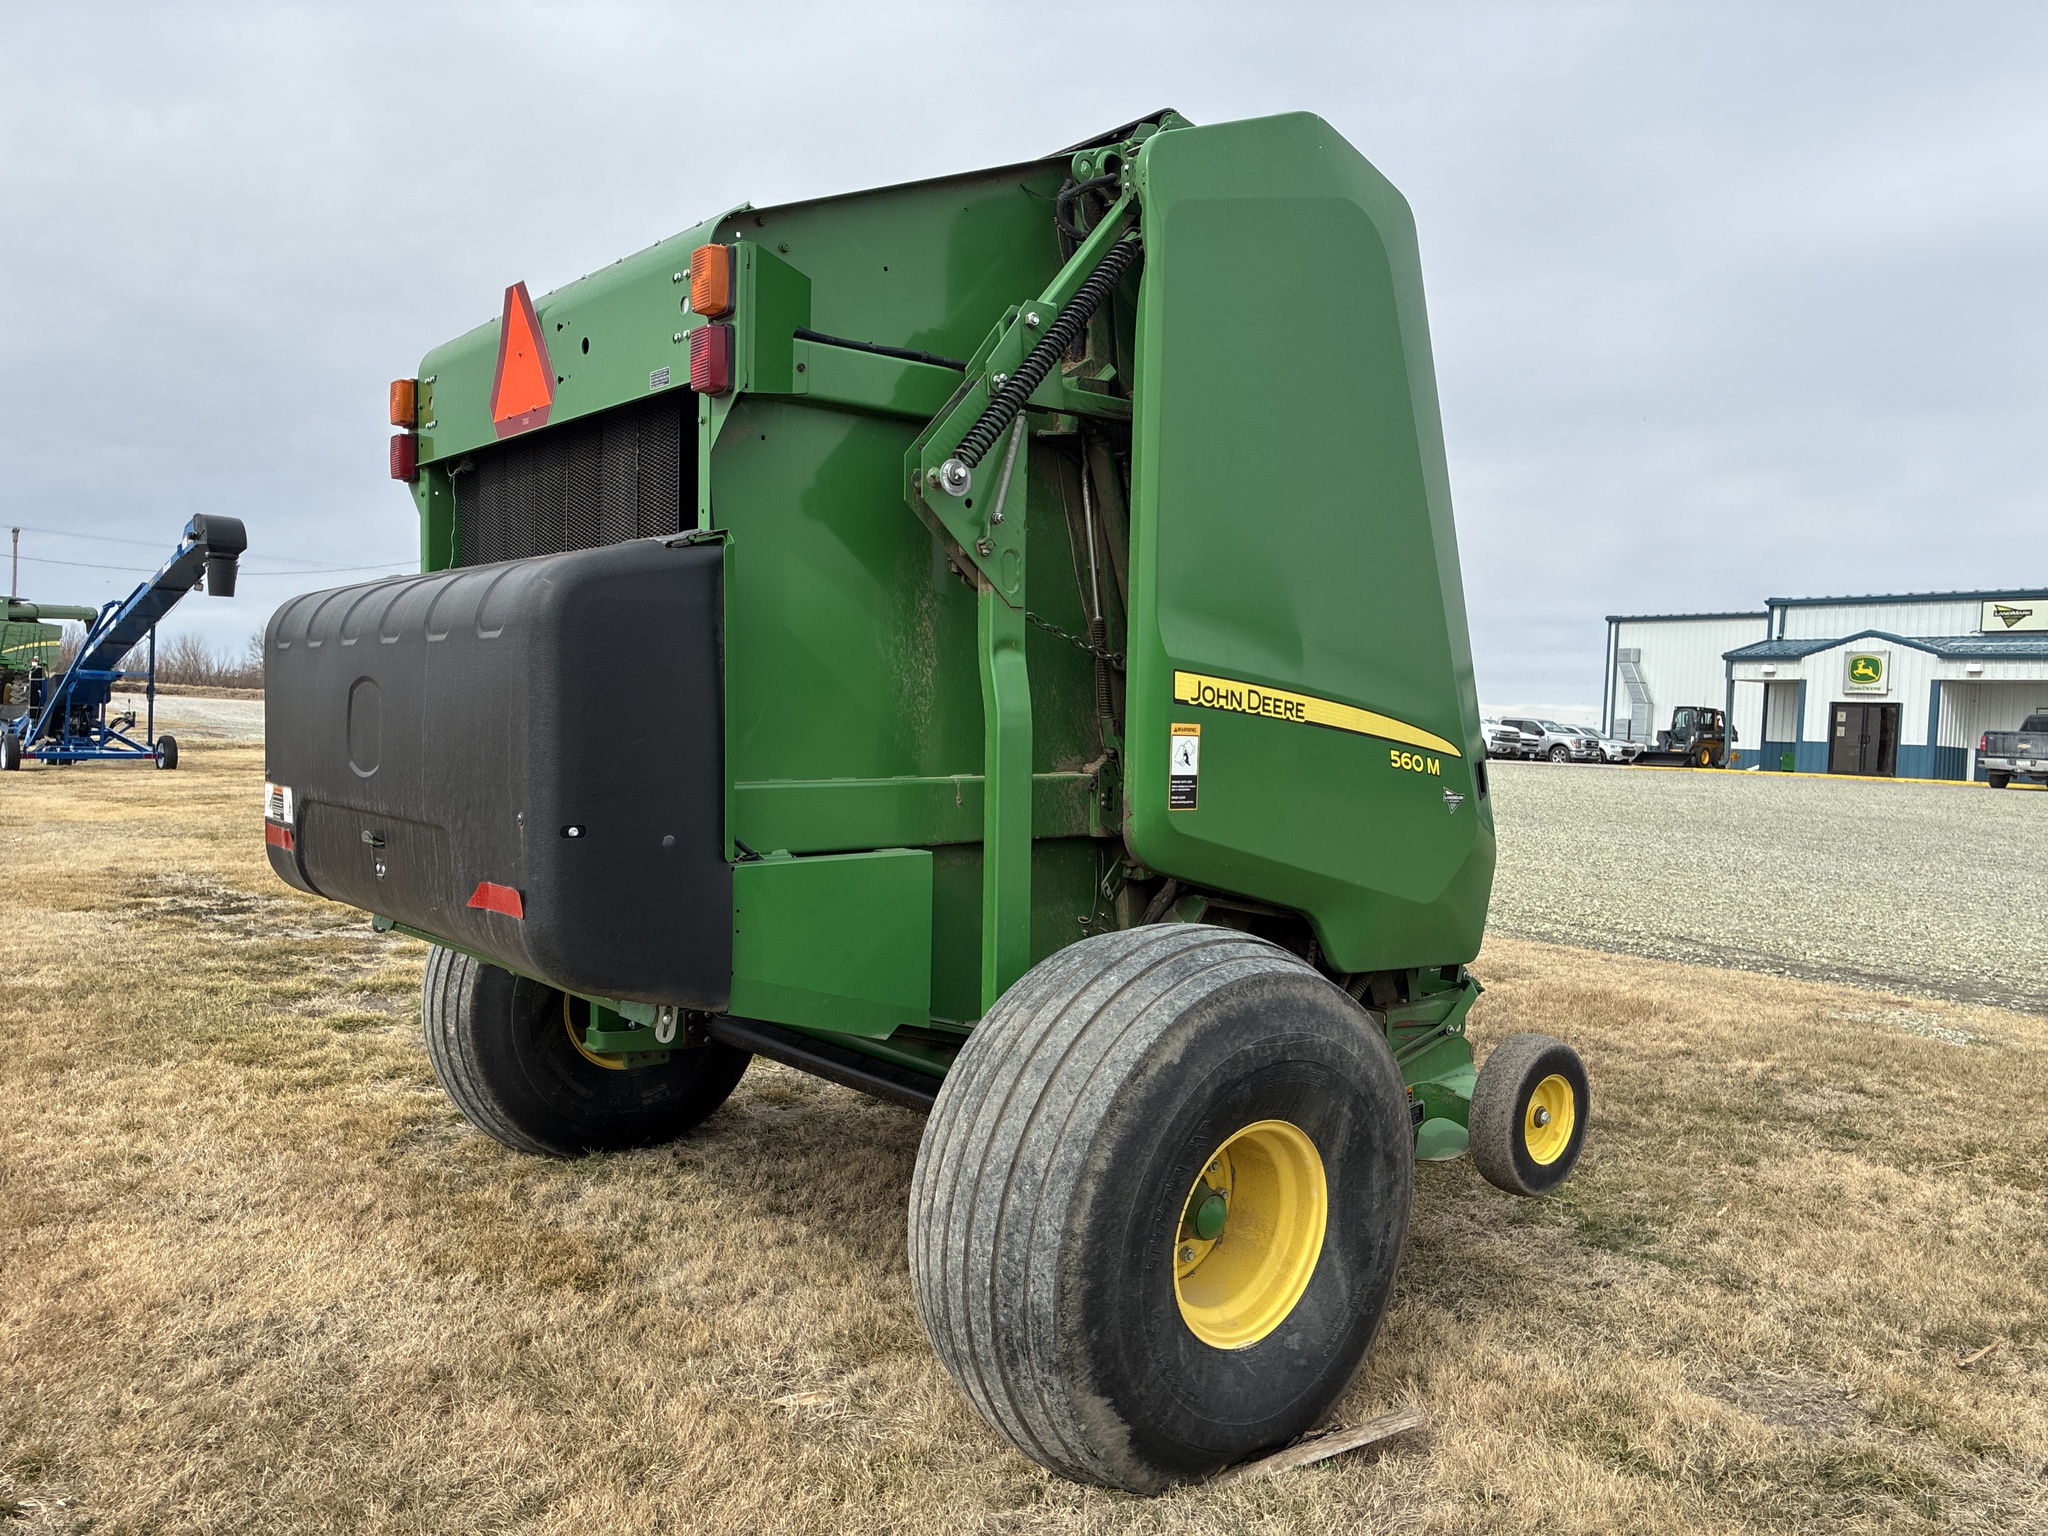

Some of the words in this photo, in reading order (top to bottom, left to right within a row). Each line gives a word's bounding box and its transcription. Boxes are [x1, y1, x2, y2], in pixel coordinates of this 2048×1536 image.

[1190, 680, 1243, 709] JOHN
[1247, 688, 1306, 720] DEERE
[1390, 749, 1424, 773] 560
[1426, 757, 1441, 777] M
